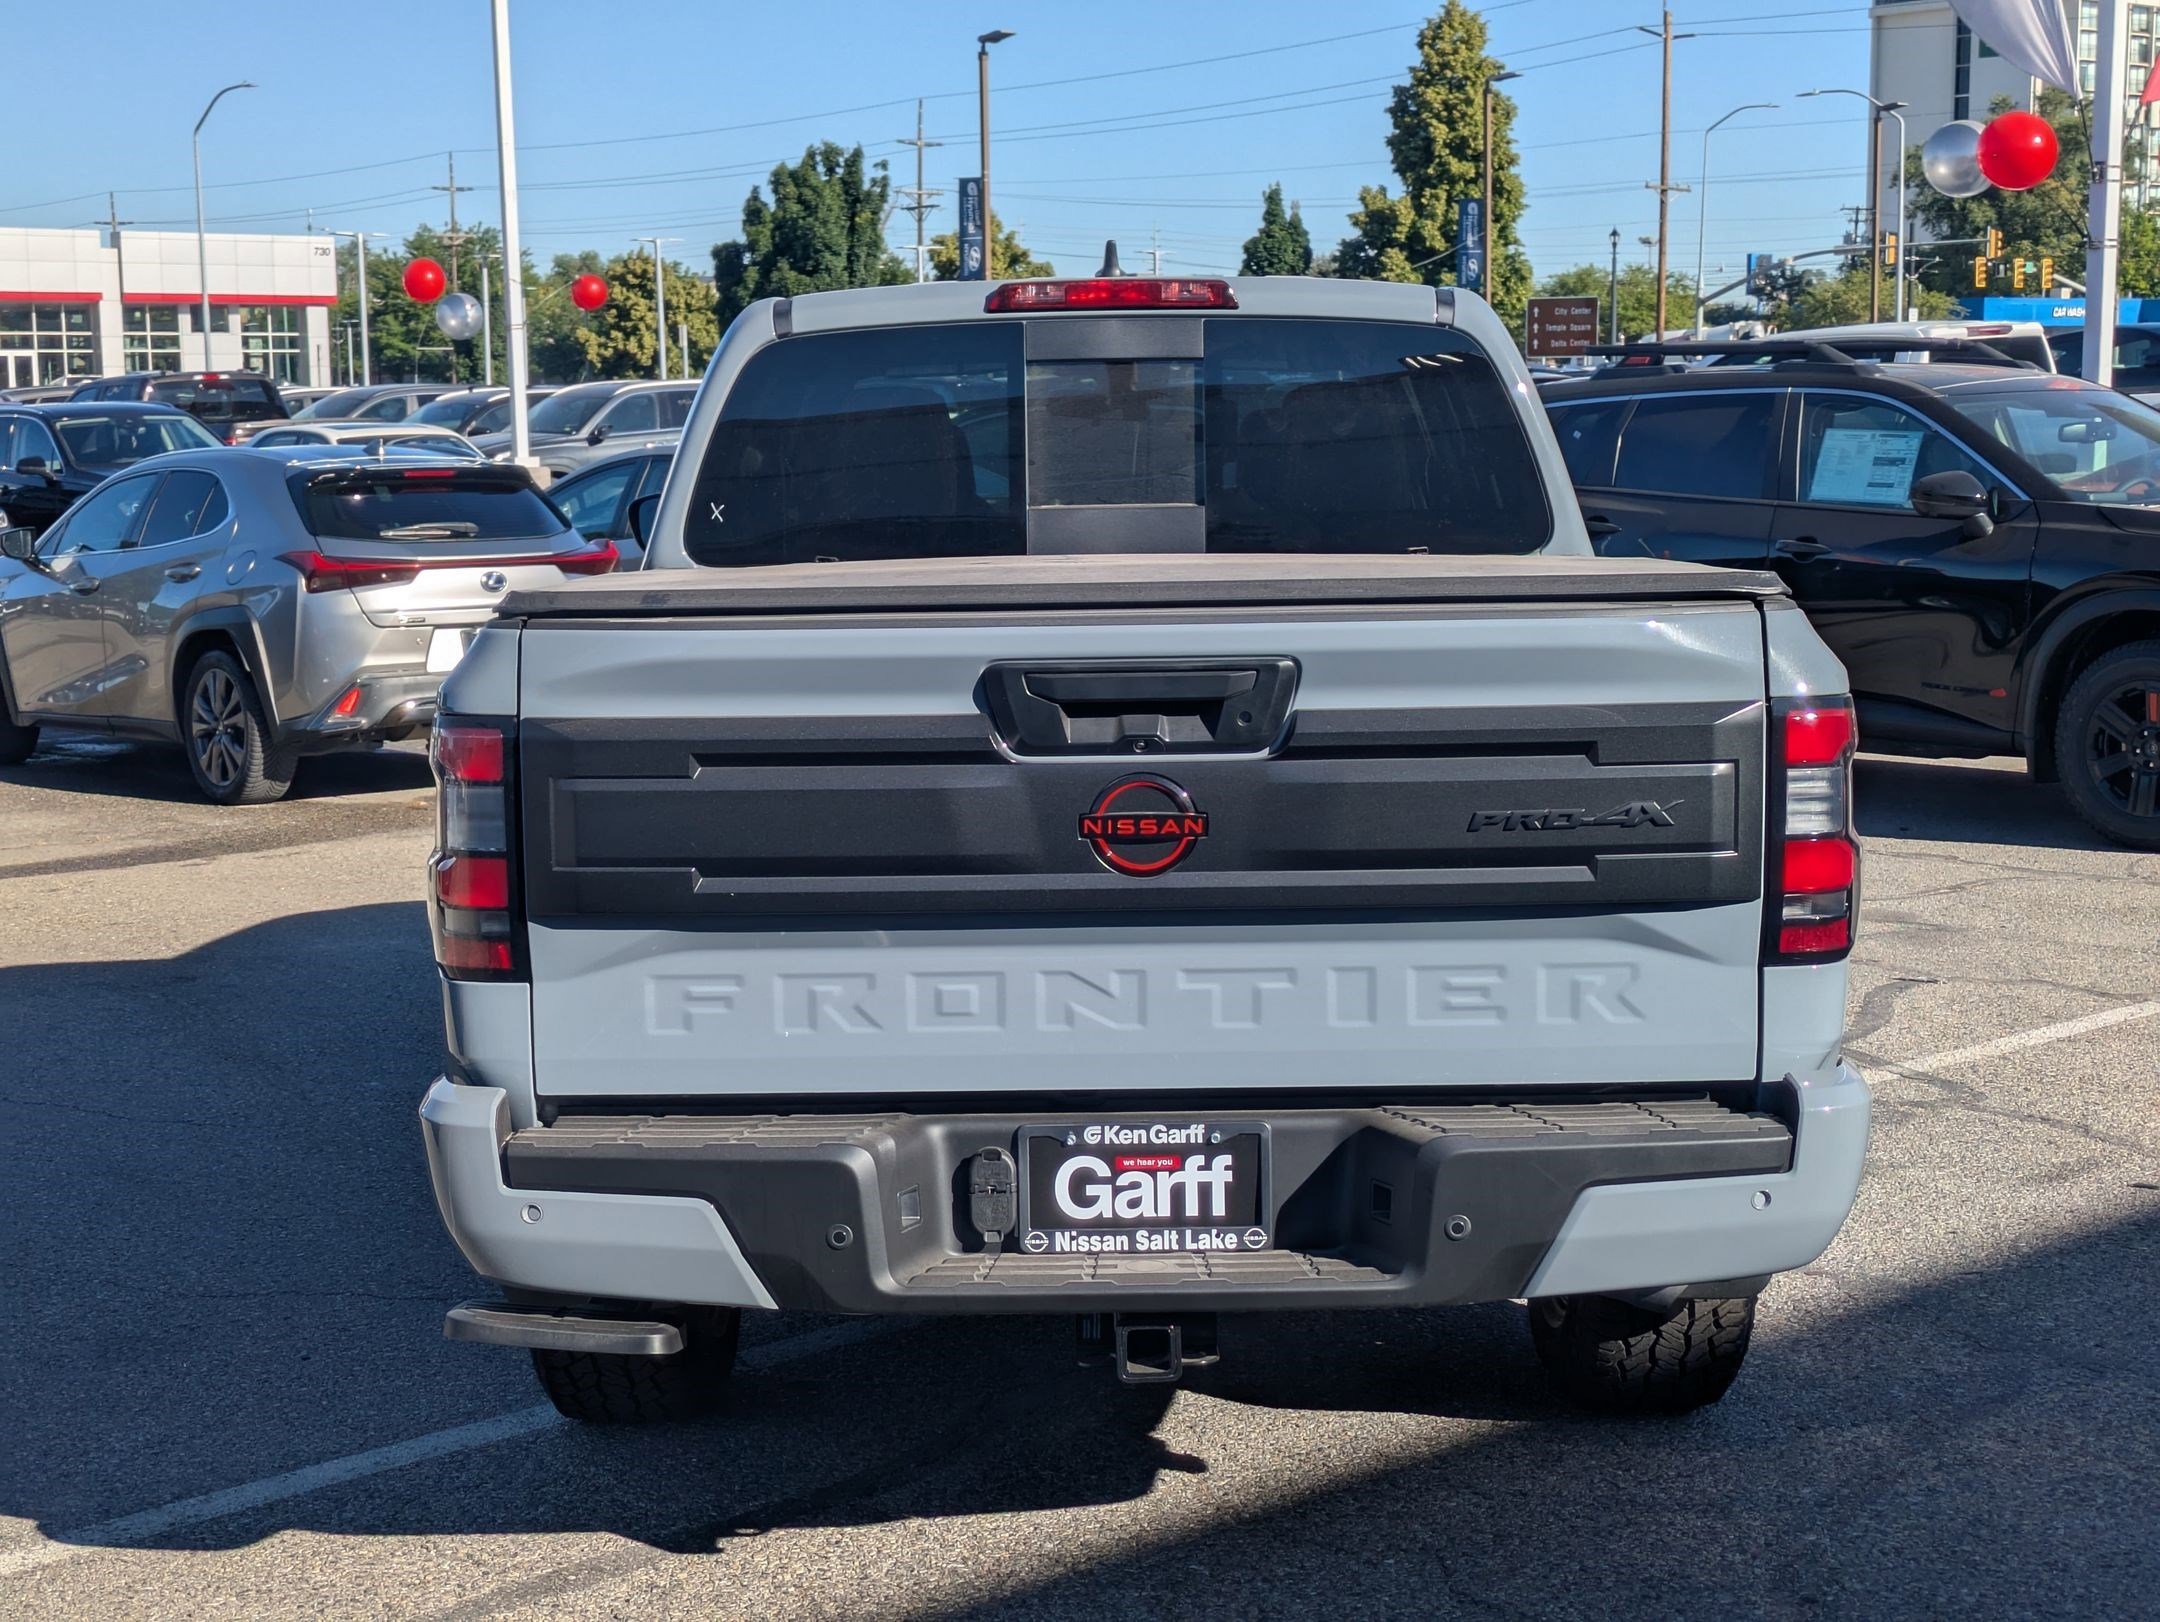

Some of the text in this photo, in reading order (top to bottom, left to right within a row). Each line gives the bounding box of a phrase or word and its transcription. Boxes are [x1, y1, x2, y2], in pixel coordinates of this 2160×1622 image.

[314, 247, 331, 256] 730
[1554, 307, 1592, 316] City Center
[2053, 307, 2066, 317] CAR
[1546, 323, 1591, 332] Temple Square
[1551, 339, 1567, 347] Delta
[1466, 799, 1685, 833] PRO-4X
[1083, 818, 1204, 835] NISSAN
[644, 961, 1647, 1036] FRONTIER
[1104, 1124, 1205, 1145] Ken Garff
[1123, 1158, 1173, 1168] we hear you
[1054, 1154, 1233, 1220] Garff
[1055, 1229, 1238, 1252] Nissan Salt Lake
